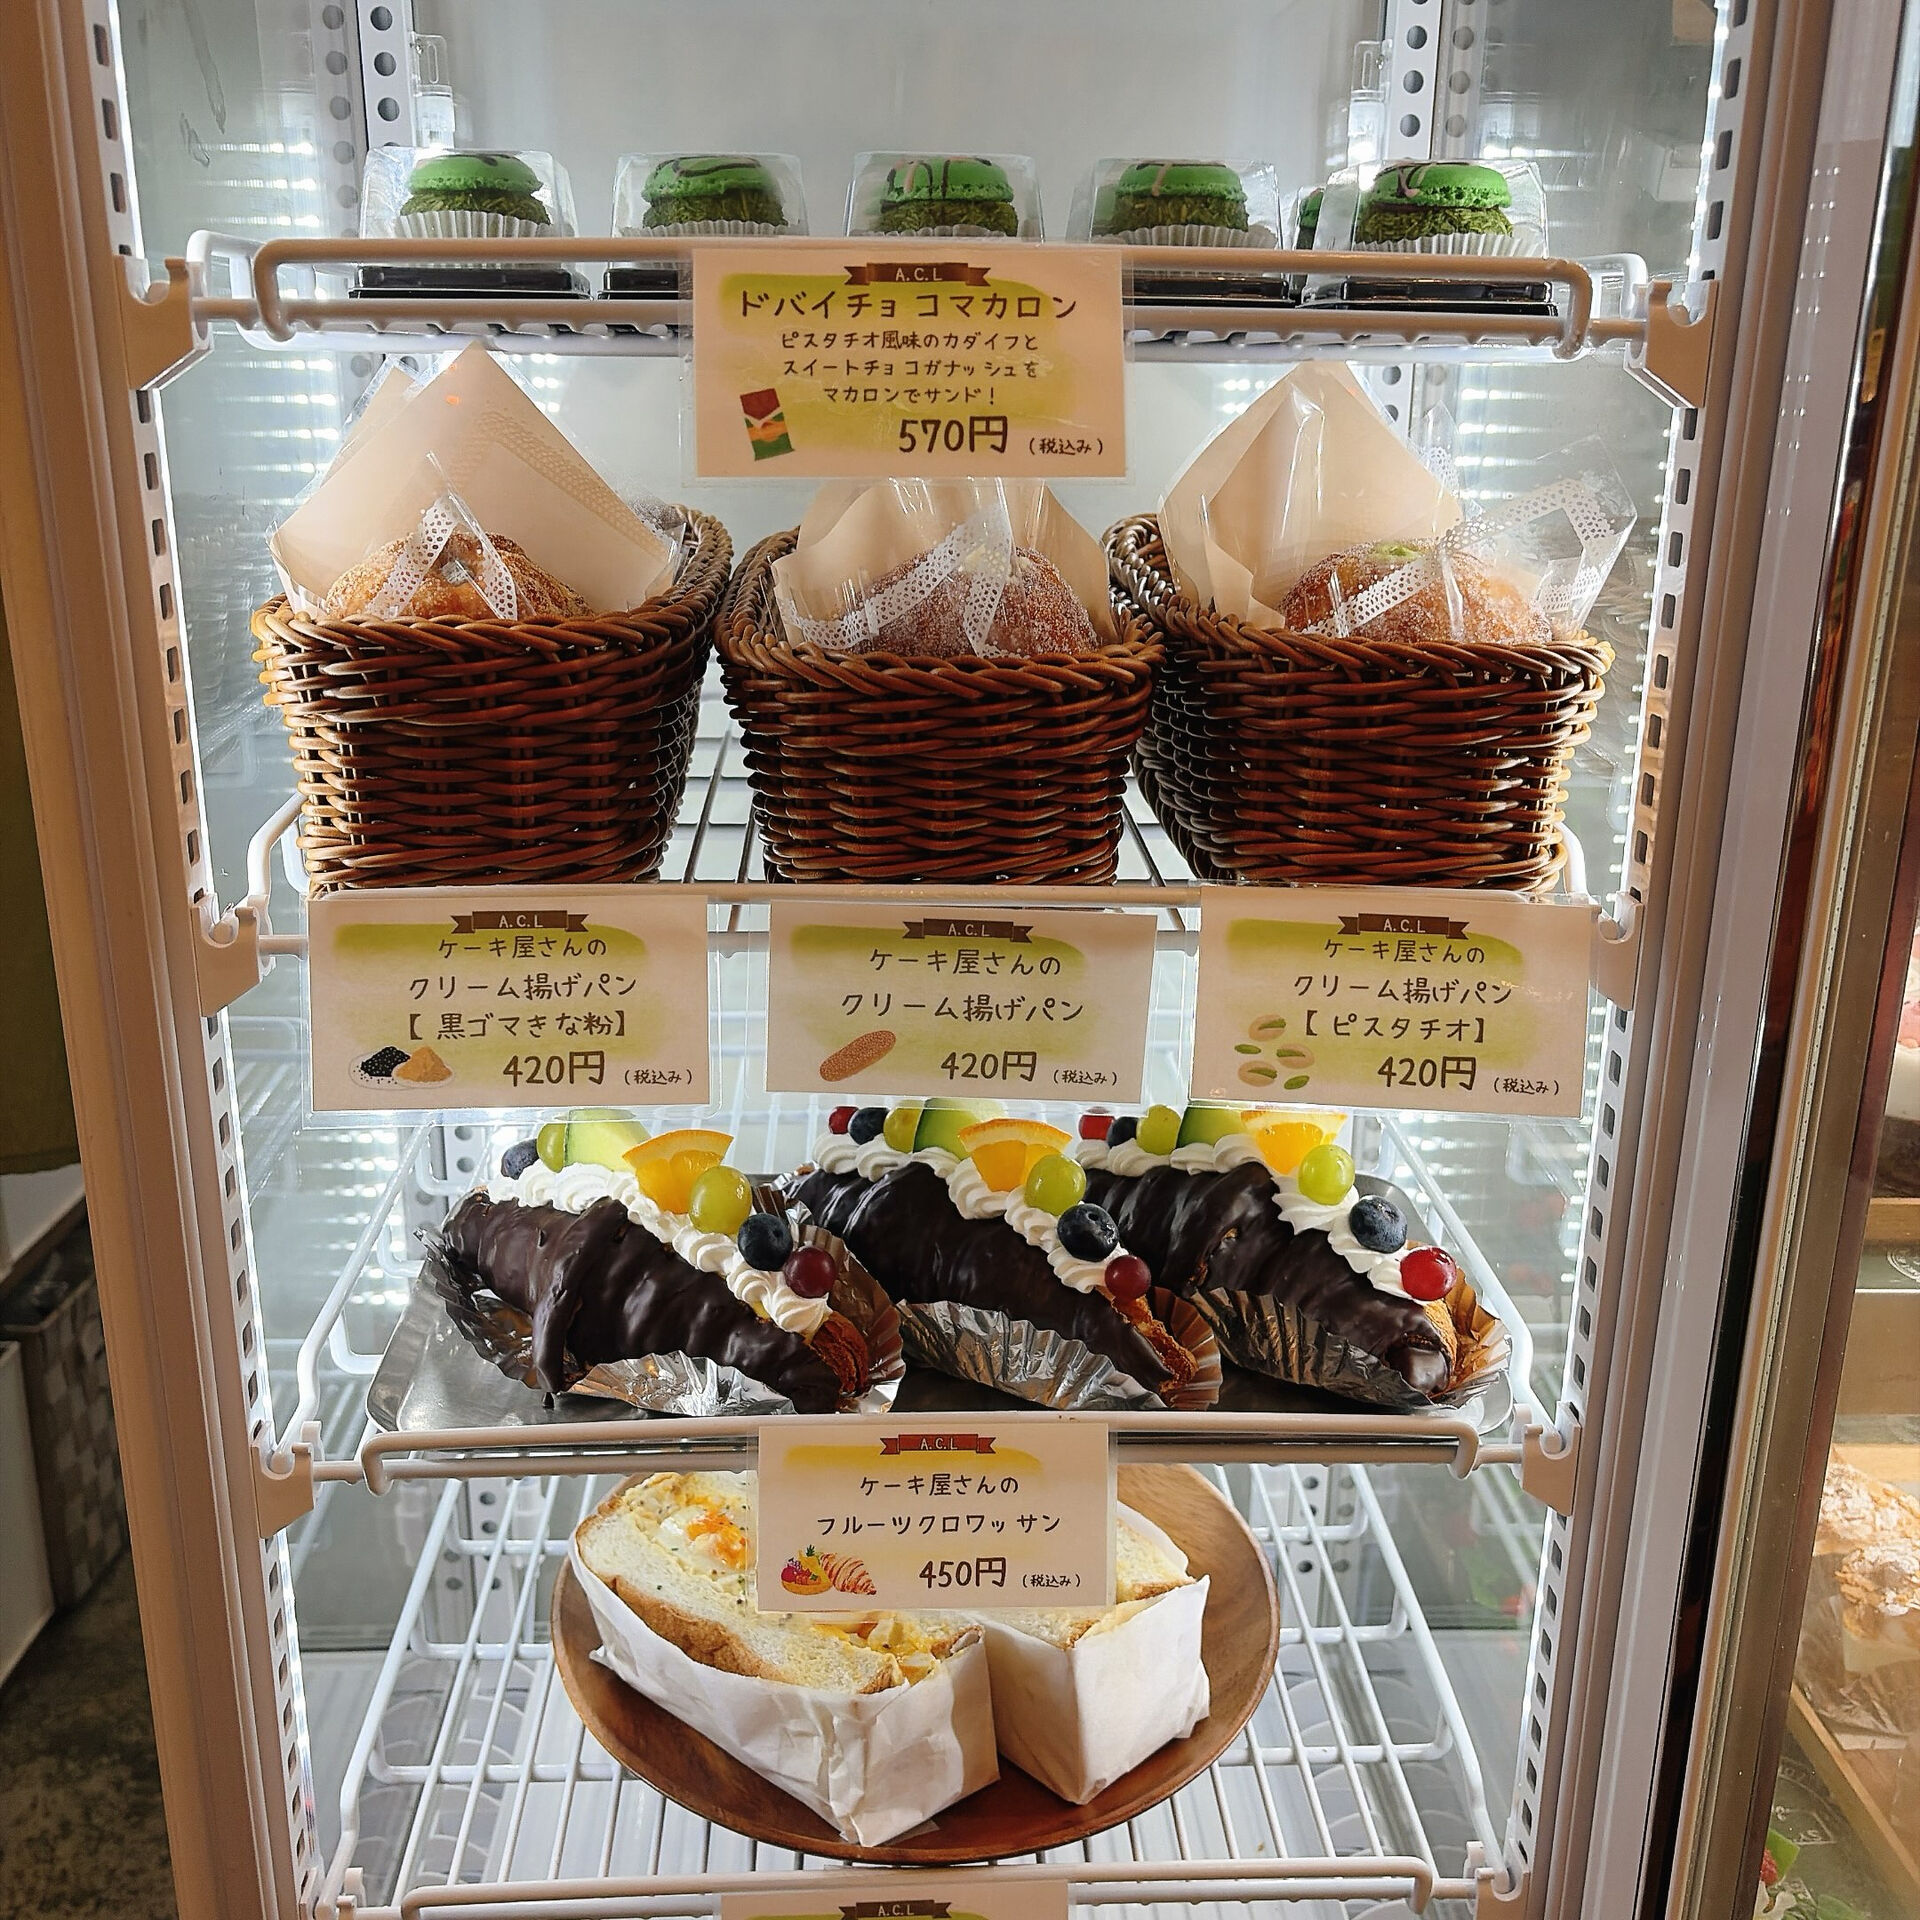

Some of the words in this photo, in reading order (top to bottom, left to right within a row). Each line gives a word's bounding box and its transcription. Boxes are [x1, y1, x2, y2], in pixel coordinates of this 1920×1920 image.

[895, 267, 944, 282] A.C.L
[741, 290, 1077, 319] ドバイチョコマカロン
[781, 330, 1039, 351] ピスタチオ風味のカダイフと
[783, 359, 1039, 378] スイートチョコガナッシュを
[823, 386, 995, 406] マカロンでサンド！
[899, 415, 1008, 454] 570円
[1029, 438, 1104, 456] （税込み）
[499, 915, 543, 929] A.C.L
[948, 924, 990, 937] A.C.L
[1383, 919, 1426, 934] A.C.L
[438, 935, 607, 959] ケーキ屋さんの
[1324, 939, 1485, 964] ケーキ屋さんの
[870, 948, 1061, 975] ケーキ屋さんの
[409, 973, 637, 1001] クリーム揚げパン
[1294, 974, 1512, 1004] クリーム揚げパン
[841, 993, 1084, 1022] クリーム揚げパン
[410, 1010, 626, 1040] 【黒ゴマきな粉】
[1305, 1009, 1485, 1043] 【ピスタチオ】
[503, 1050, 605, 1087] 420円
[624, 1069, 693, 1085] （税込み）
[940, 1051, 1037, 1081] 420円
[1053, 1070, 1117, 1085] （税込み）
[1377, 1056, 1477, 1091] 420円
[1493, 1077, 1559, 1095] （税込み）
[920, 1438, 958, 1450] A.C.L
[860, 1473, 1019, 1497] ケーキ屋さんの
[817, 1514, 1060, 1535] フルーツクロワッサン
[918, 1557, 1007, 1589] 450円
[1022, 1573, 1081, 1588] （税込み）
[878, 1904, 915, 1917] A.C.L
